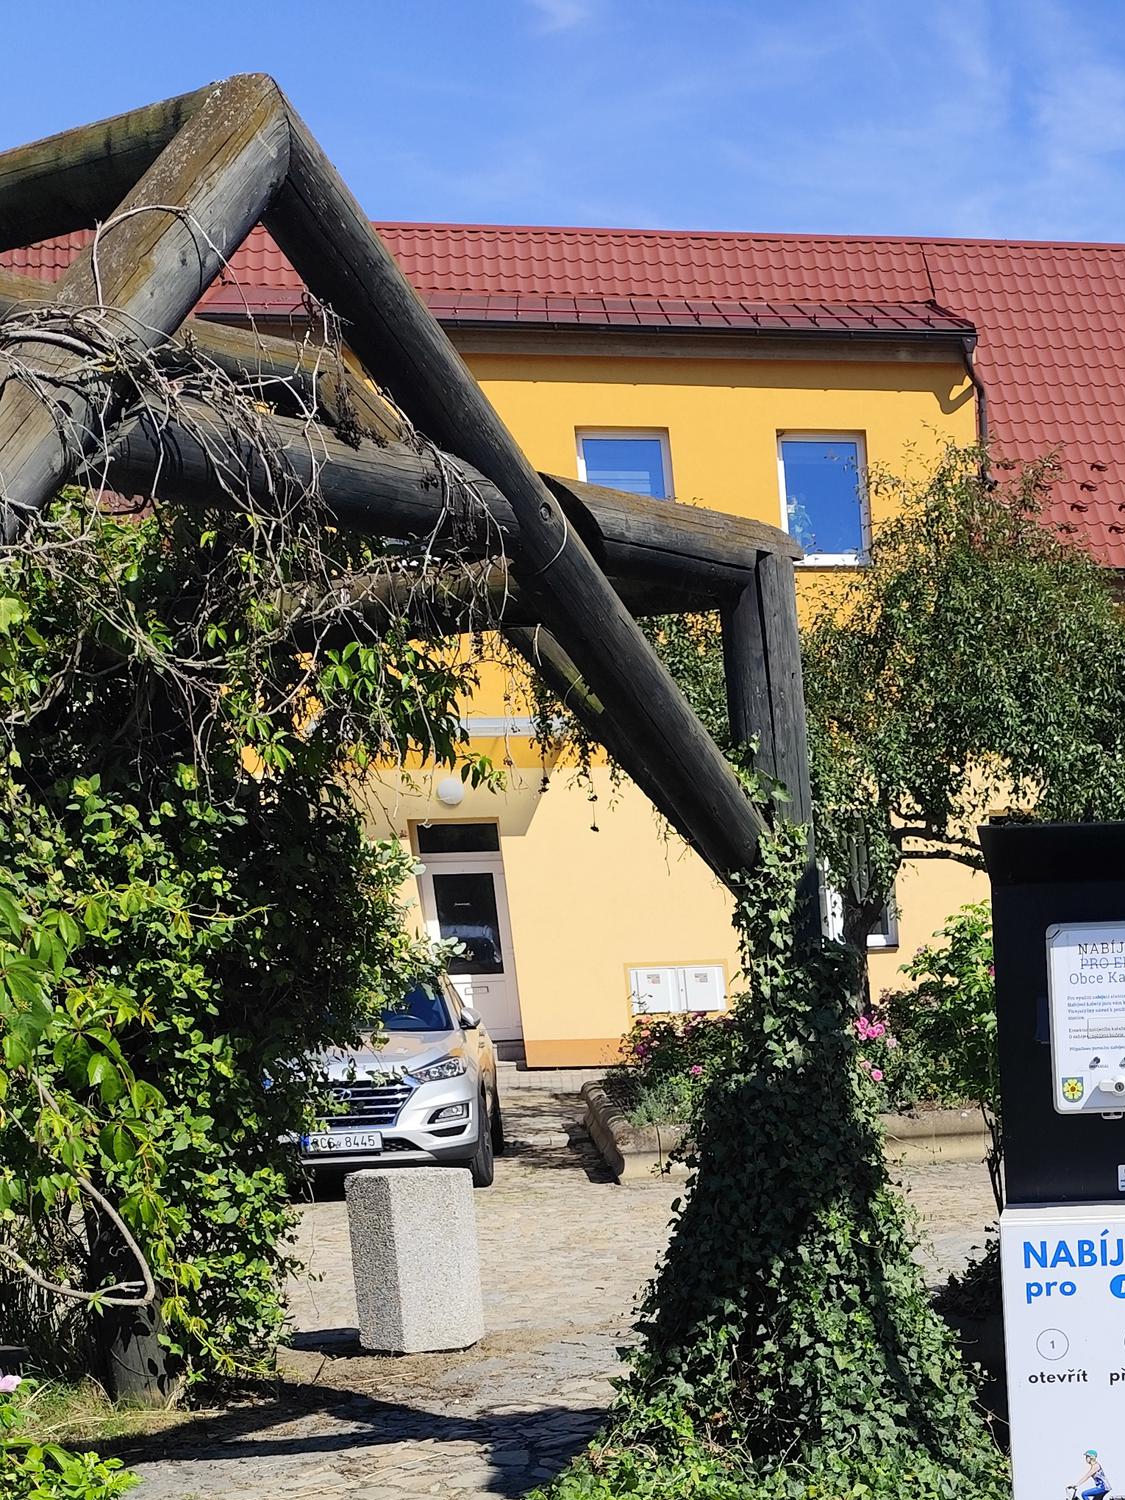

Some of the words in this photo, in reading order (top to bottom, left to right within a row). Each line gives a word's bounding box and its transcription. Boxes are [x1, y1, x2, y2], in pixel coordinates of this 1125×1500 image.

[1080, 957, 1109, 970] PRO
[1069, 972, 1103, 985] Obce
[345, 1135, 376, 1147] 8445
[1026, 1278, 1077, 1304] pro
[1028, 1366, 1088, 1384] otevřít
